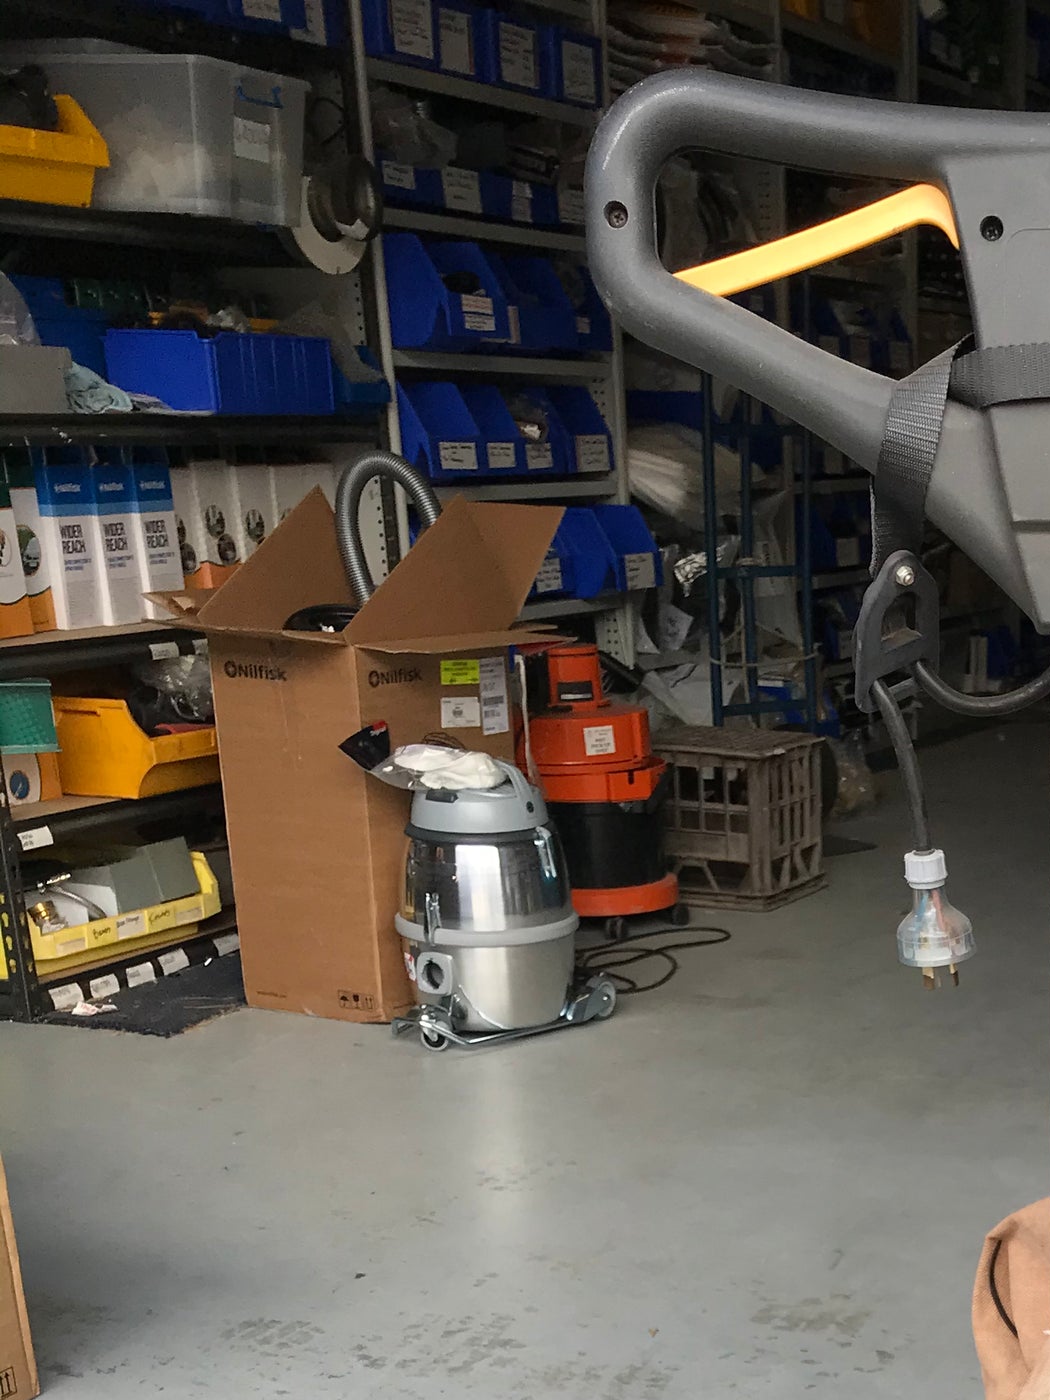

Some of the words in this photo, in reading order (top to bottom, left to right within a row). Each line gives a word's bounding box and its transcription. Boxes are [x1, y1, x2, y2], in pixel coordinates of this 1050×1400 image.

[60, 524, 83, 539] WIDER
[103, 522, 126, 537] WIDER
[144, 519, 167, 533] WIDER
[62, 540, 86, 554] REACH
[105, 537, 128, 551] REACH
[146, 534, 169, 548] REACH
[238, 663, 287, 681] Nilfisk
[380, 667, 422, 685] Nilfisk
